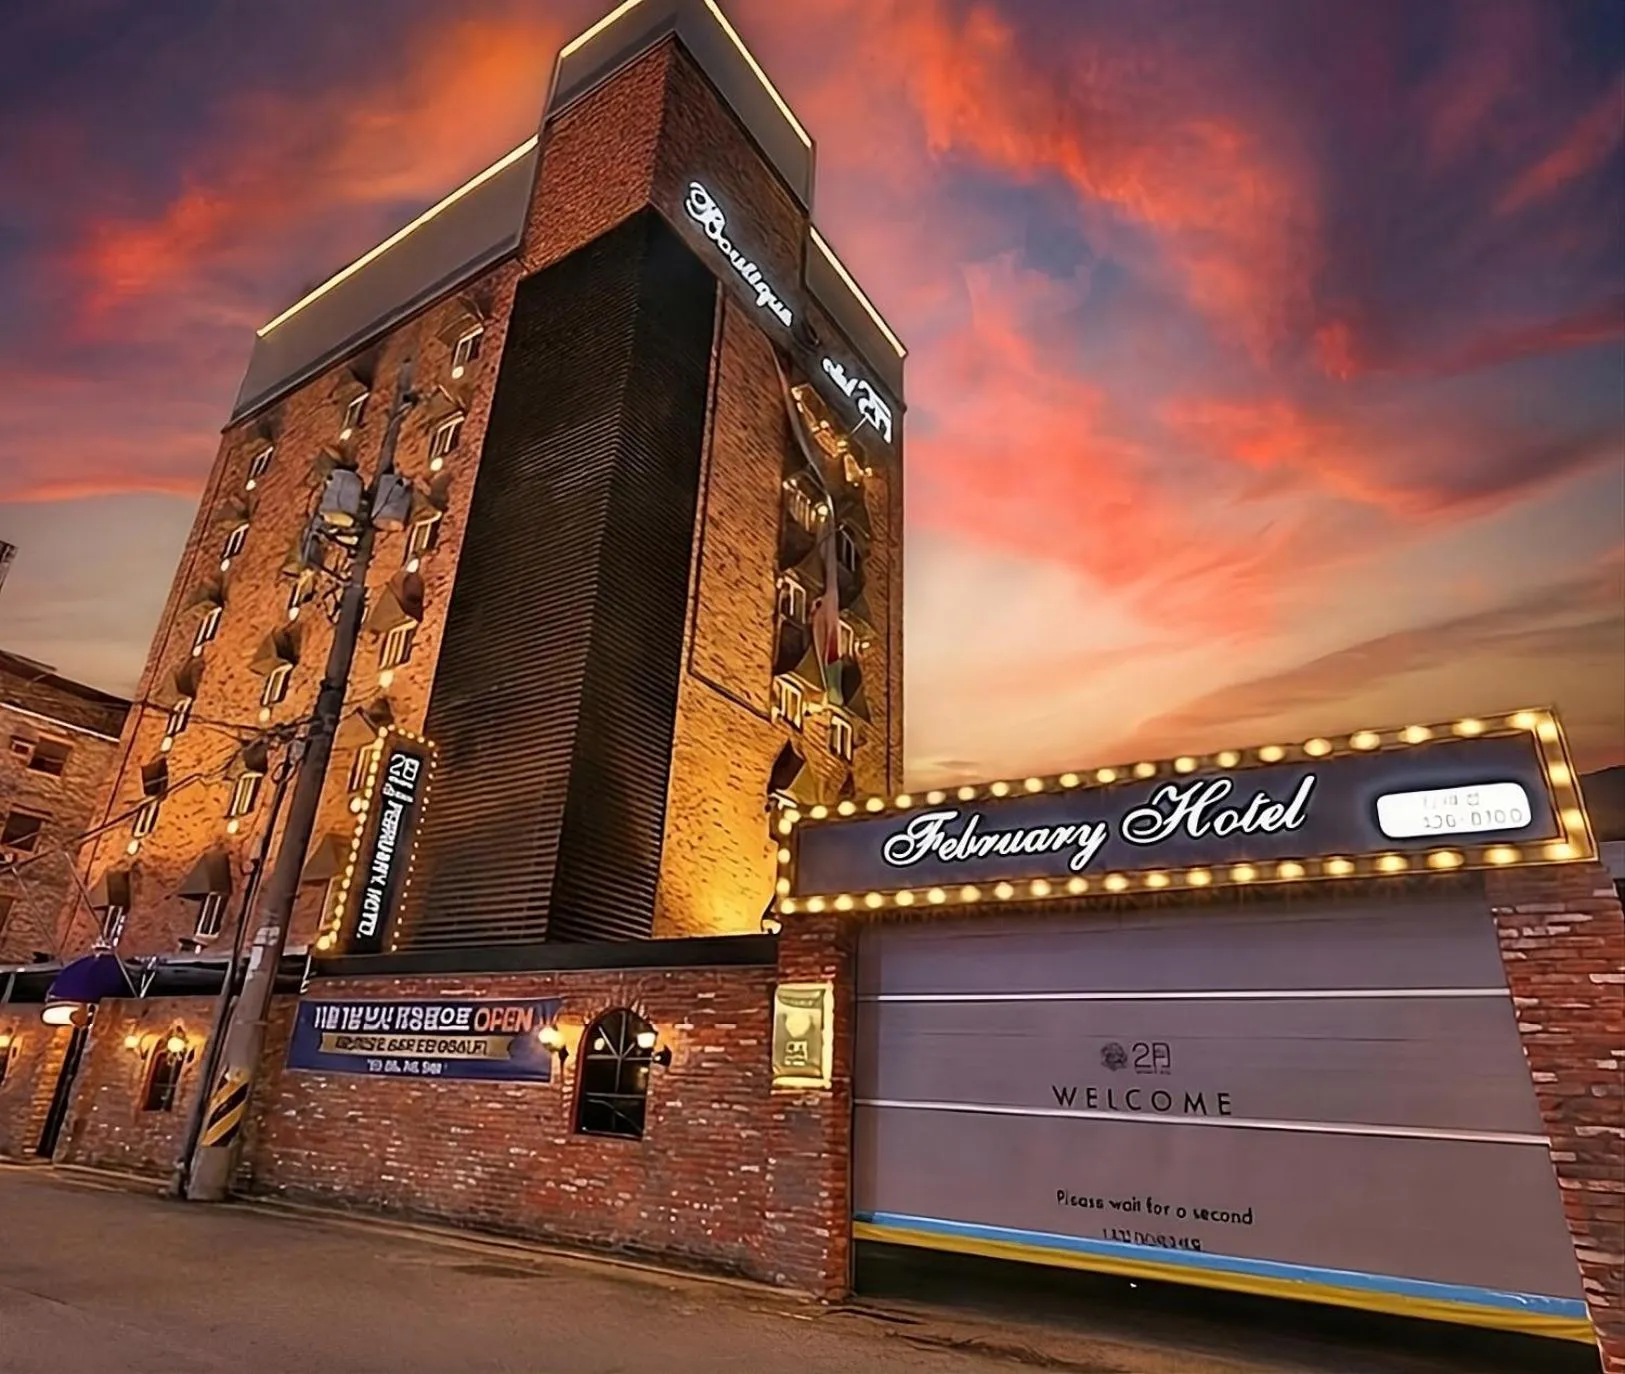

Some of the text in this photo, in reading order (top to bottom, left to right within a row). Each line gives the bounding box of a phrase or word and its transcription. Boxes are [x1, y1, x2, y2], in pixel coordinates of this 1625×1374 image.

[884, 775, 1315, 871] February Hotel
[1052, 1085, 1232, 1116] WELCOME
[1056, 1190, 1104, 1209] Please
[1108, 1196, 1141, 1212] wait
[1146, 1197, 1170, 1216] for
[1193, 1207, 1254, 1225] second
